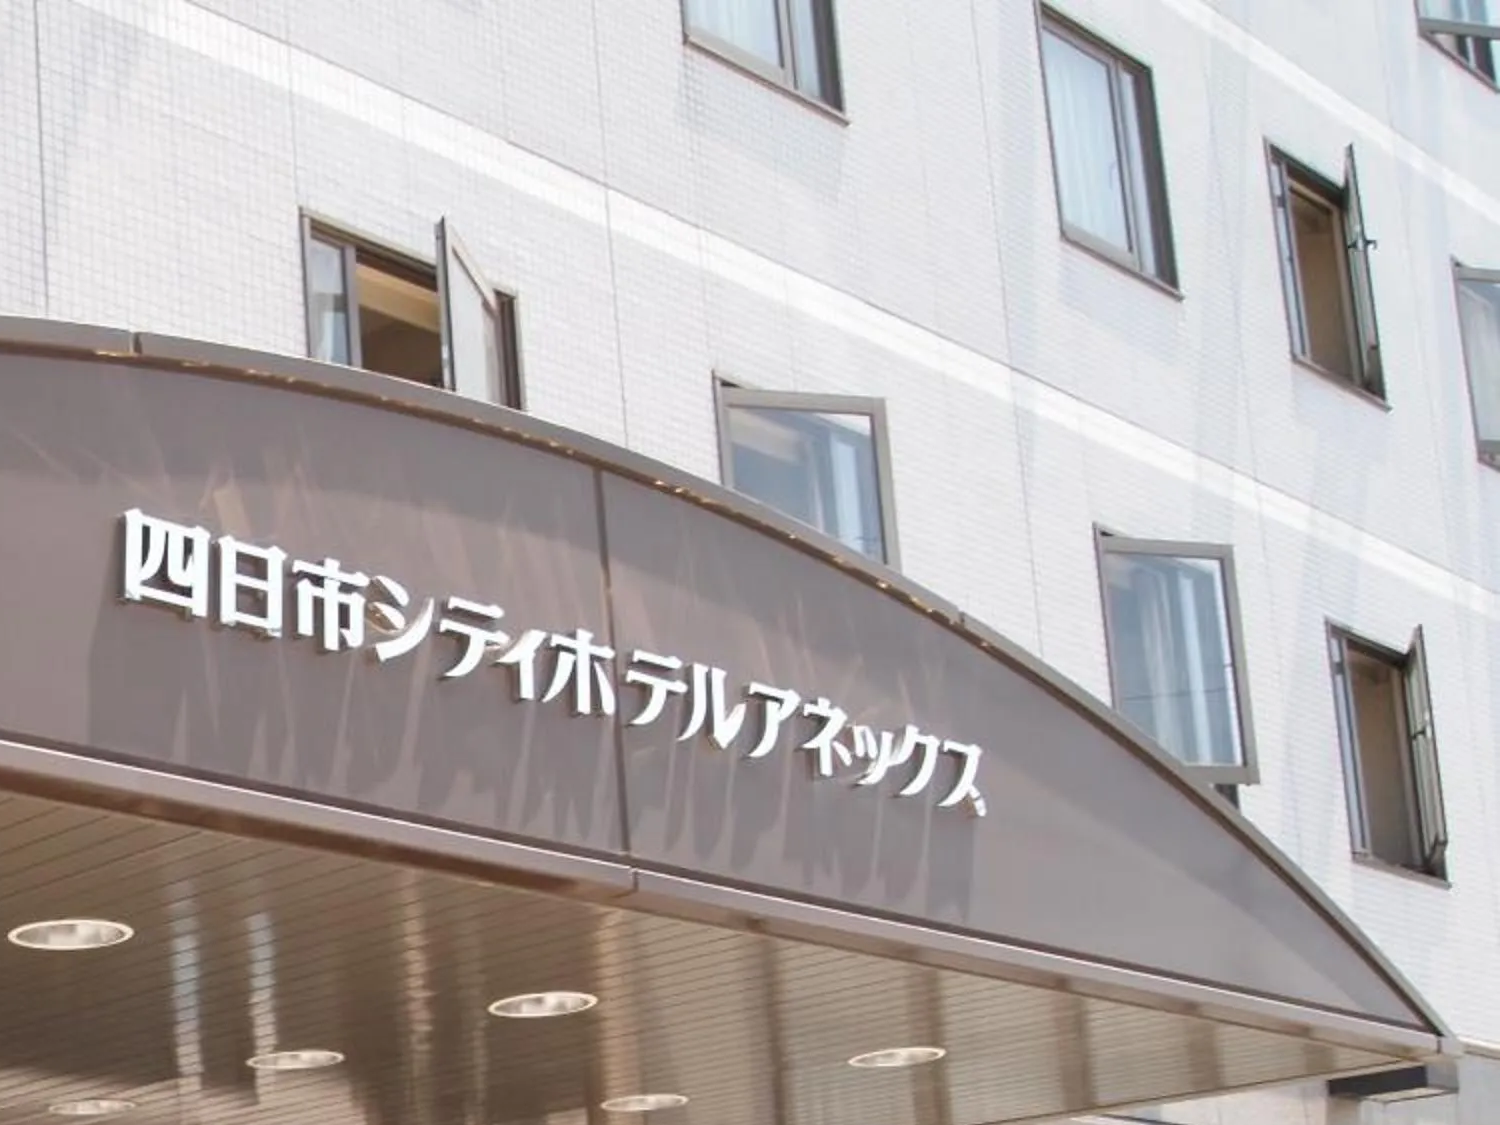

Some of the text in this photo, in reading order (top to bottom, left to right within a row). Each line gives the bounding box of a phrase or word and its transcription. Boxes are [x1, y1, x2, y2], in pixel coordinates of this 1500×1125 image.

[121, 507, 987, 818] 四日市シティホテルアネックス
